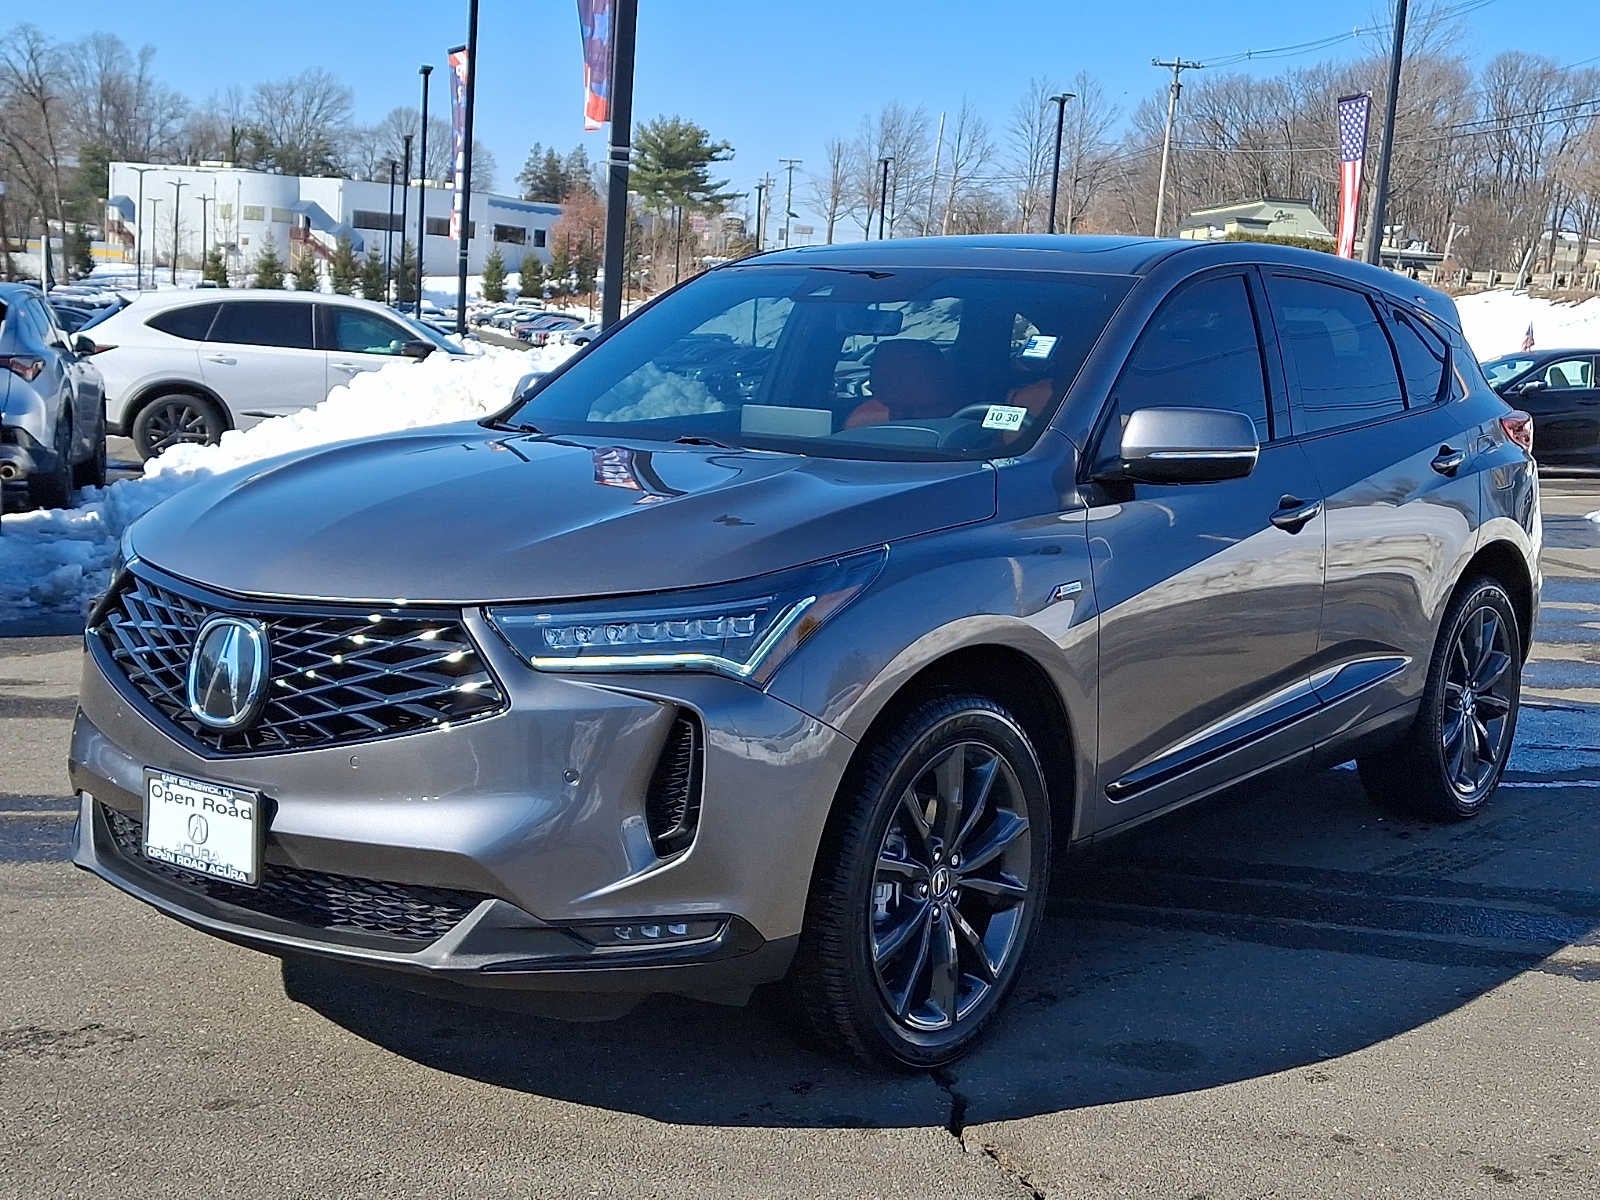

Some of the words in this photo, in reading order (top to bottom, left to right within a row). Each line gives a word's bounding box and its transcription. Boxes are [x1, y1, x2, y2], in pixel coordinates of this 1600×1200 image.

[989, 412, 1003, 421] 10
[1005, 413, 1019, 423] 30
[152, 784, 195, 807] Open
[202, 797, 252, 820] Road
[147, 846, 175, 863] OPEN
[176, 856, 207, 870] ROAD
[208, 863, 247, 882] ACURA
